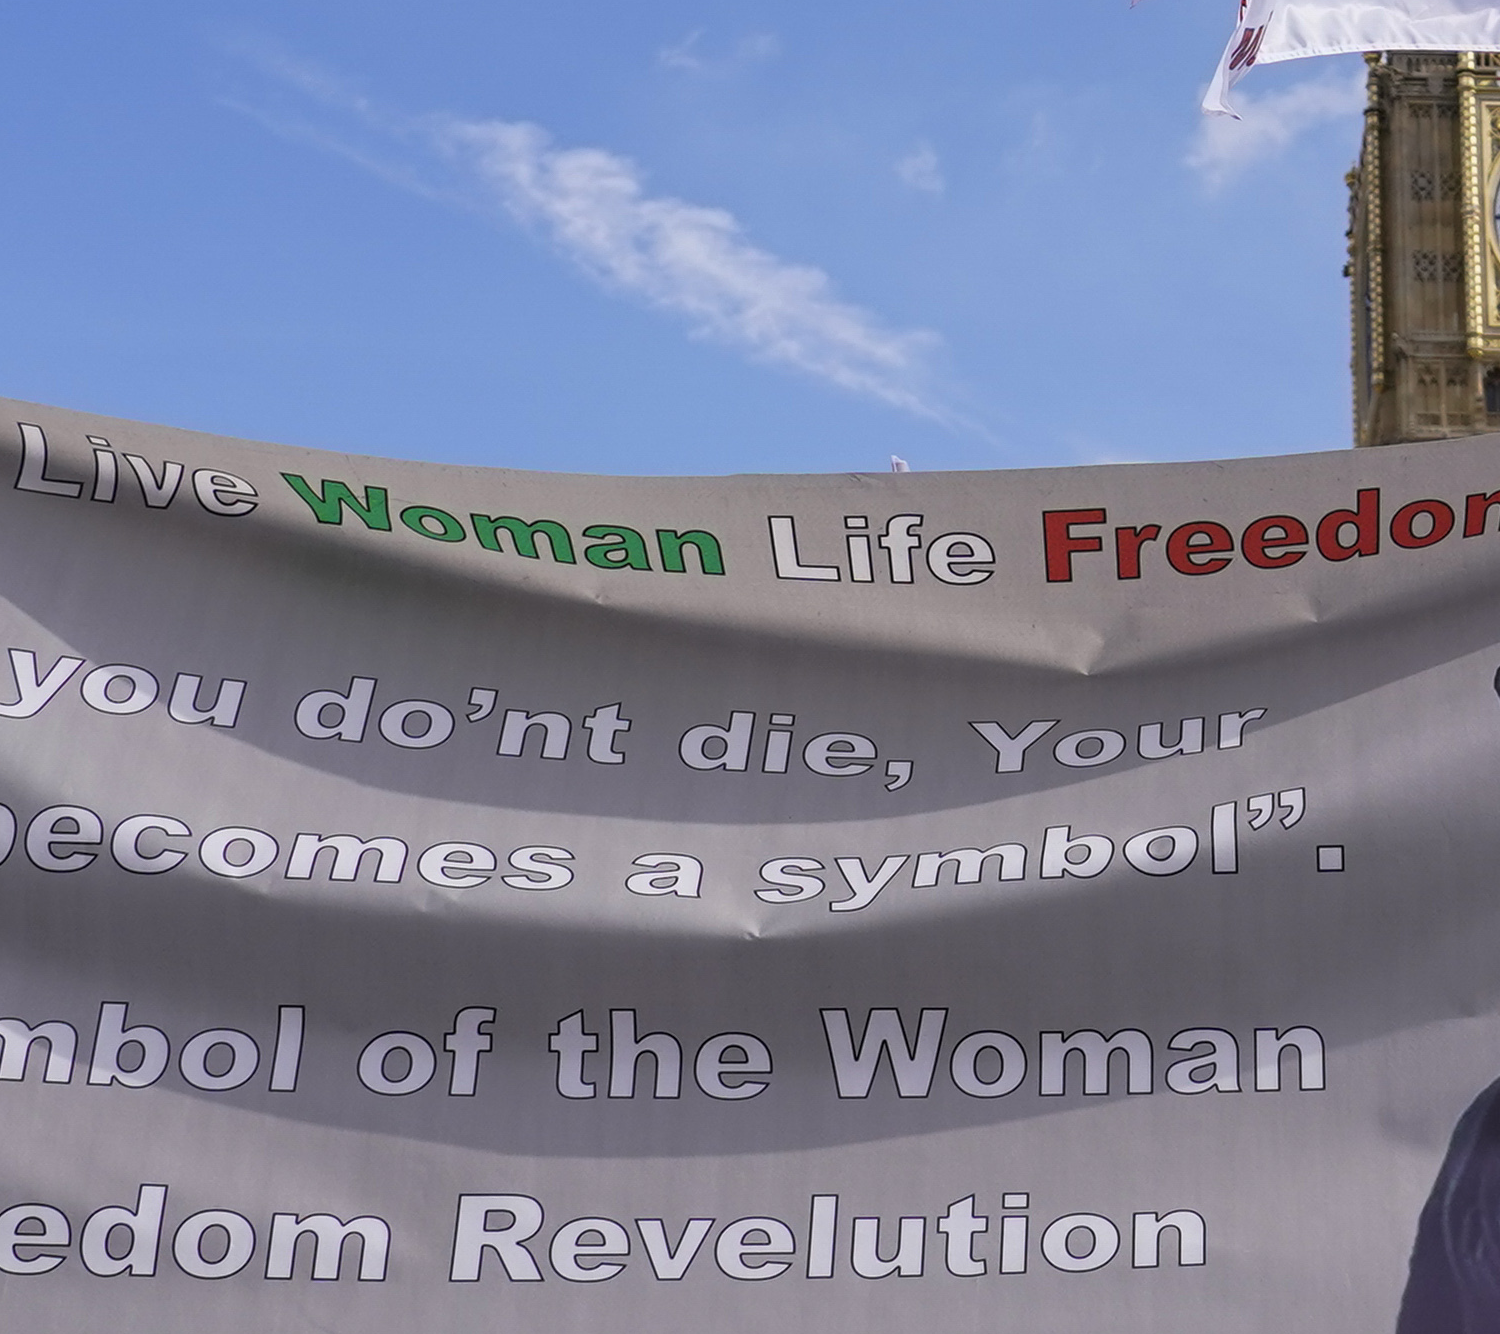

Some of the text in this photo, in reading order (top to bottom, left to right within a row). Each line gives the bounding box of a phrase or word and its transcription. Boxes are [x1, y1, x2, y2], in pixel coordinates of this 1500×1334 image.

[13, 421, 260, 519] Live
[280, 471, 728, 578] Woman
[770, 513, 997, 586] Life
[292, 674, 634, 768] do’nt
[676, 707, 915, 793] die,
[968, 701, 1268, 777] Your
[624, 848, 704, 901] a
[753, 785, 1347, 914] symbol”.
[357, 1005, 498, 1098] of
[547, 1007, 774, 1101] the
[819, 1006, 1328, 1101] Woman
[449, 1191, 1208, 1284] Revelution
